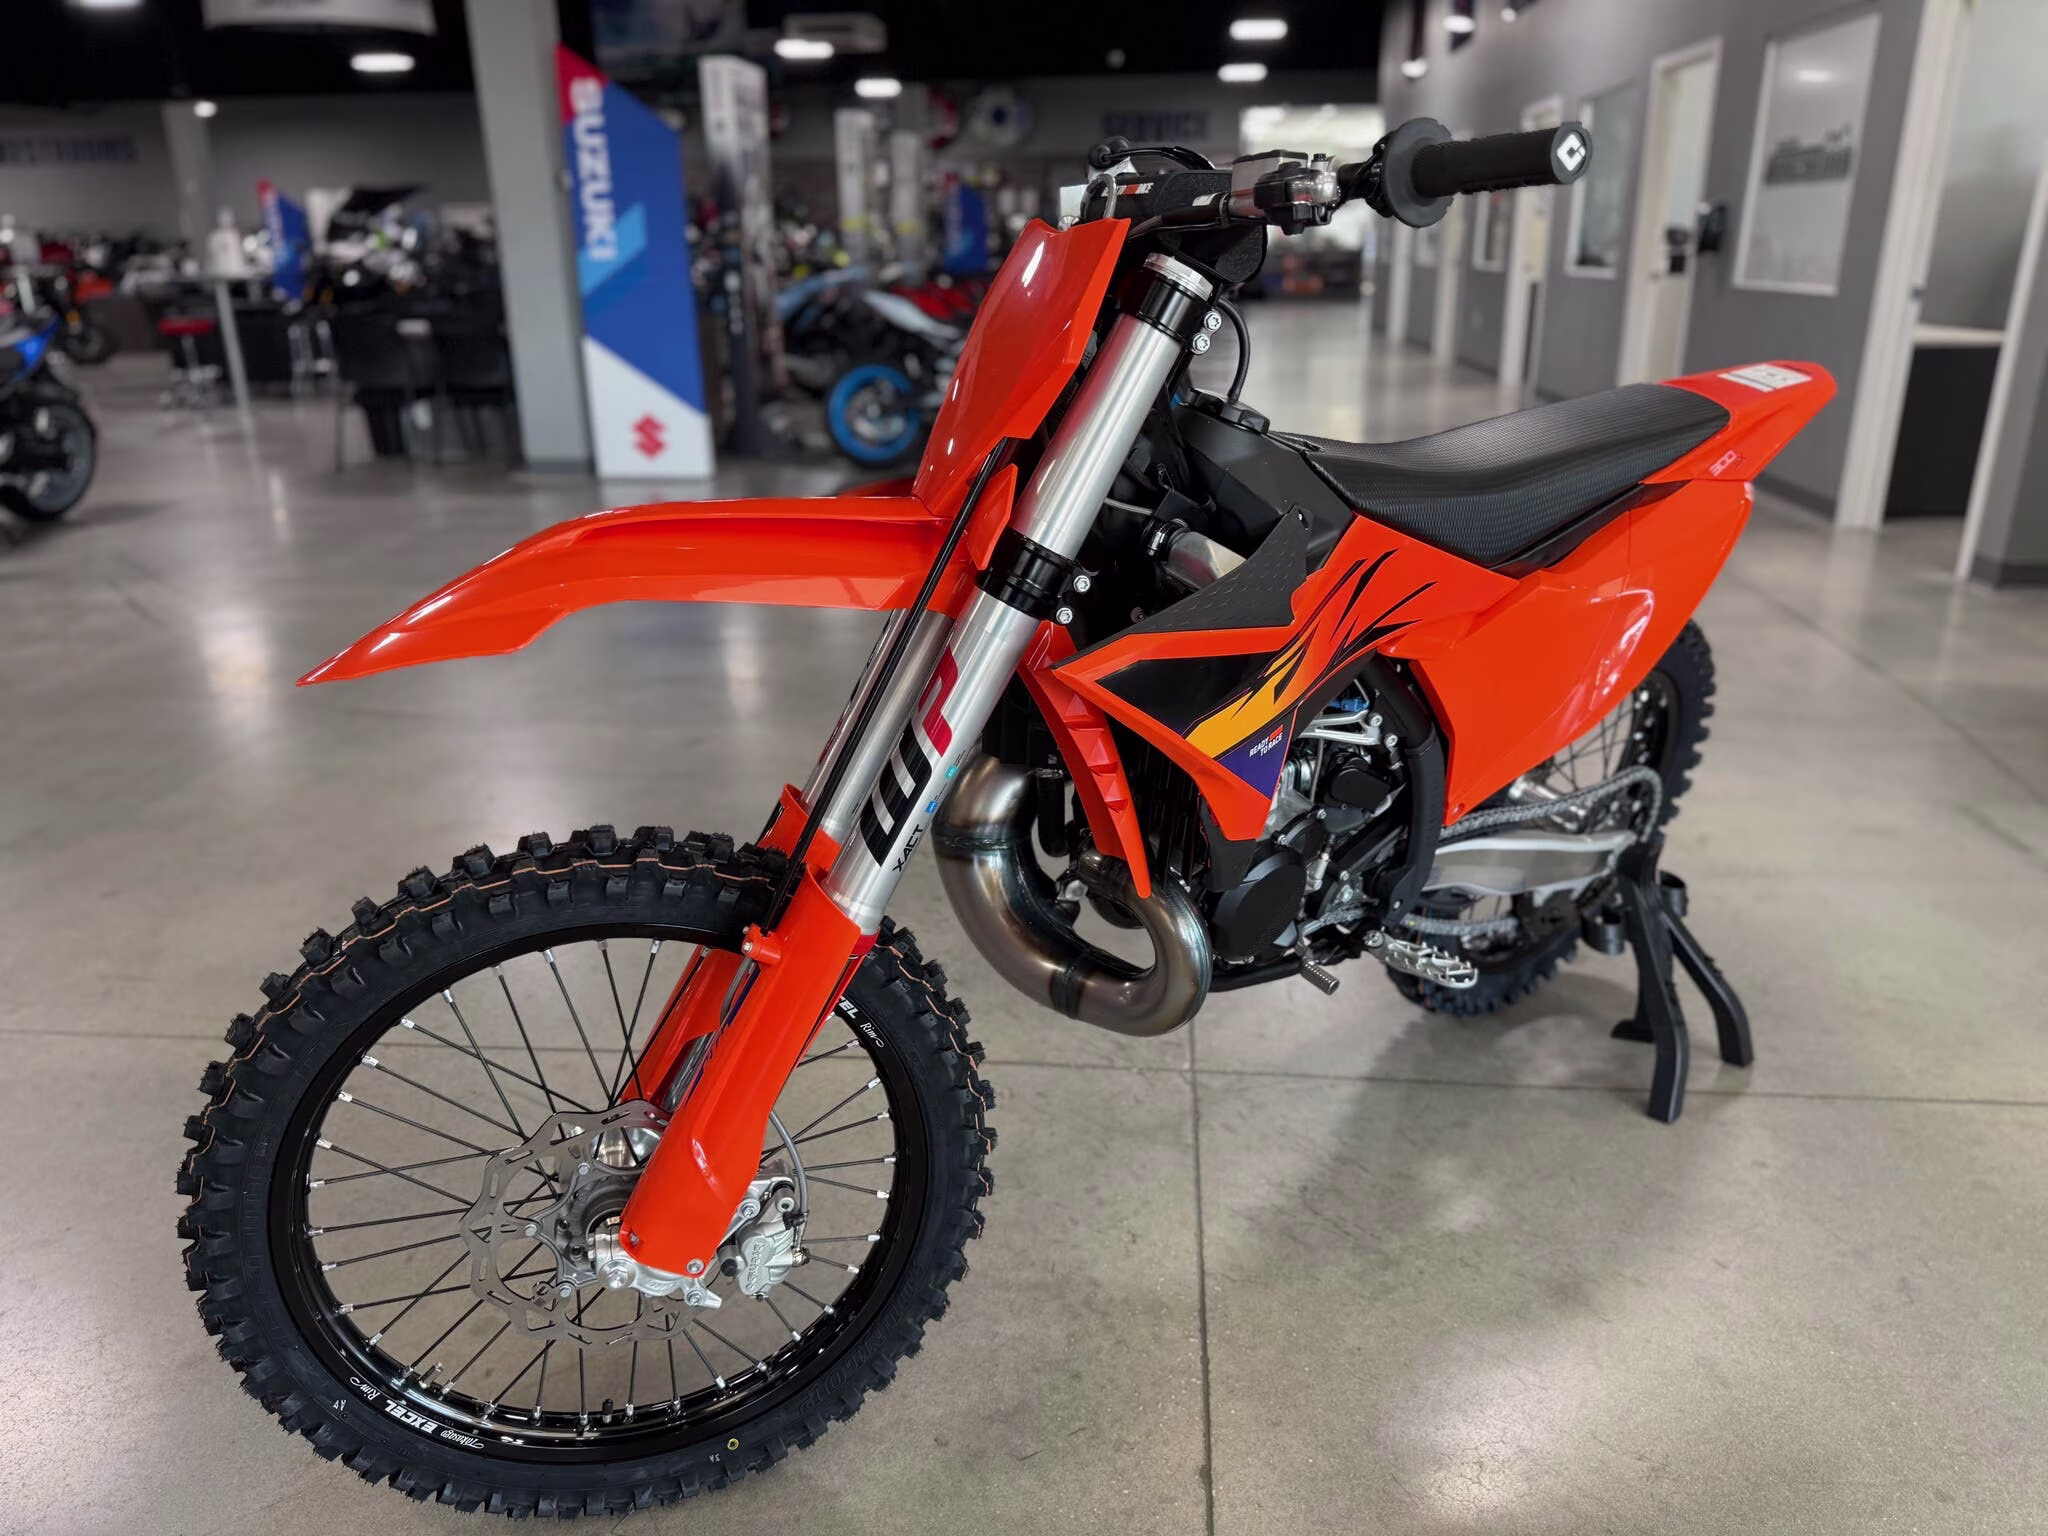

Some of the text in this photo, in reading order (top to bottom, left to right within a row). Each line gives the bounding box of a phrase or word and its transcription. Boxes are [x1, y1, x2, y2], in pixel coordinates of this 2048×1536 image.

[569, 76, 619, 261] SUZUKI
[1709, 450, 1737, 476] 300
[1249, 736, 1269, 757] READY
[1267, 732, 1283, 750] RACE
[892, 824, 924, 872] XACT
[350, 1376, 381, 1400] Rim
[384, 1399, 438, 1434] EXCEL
